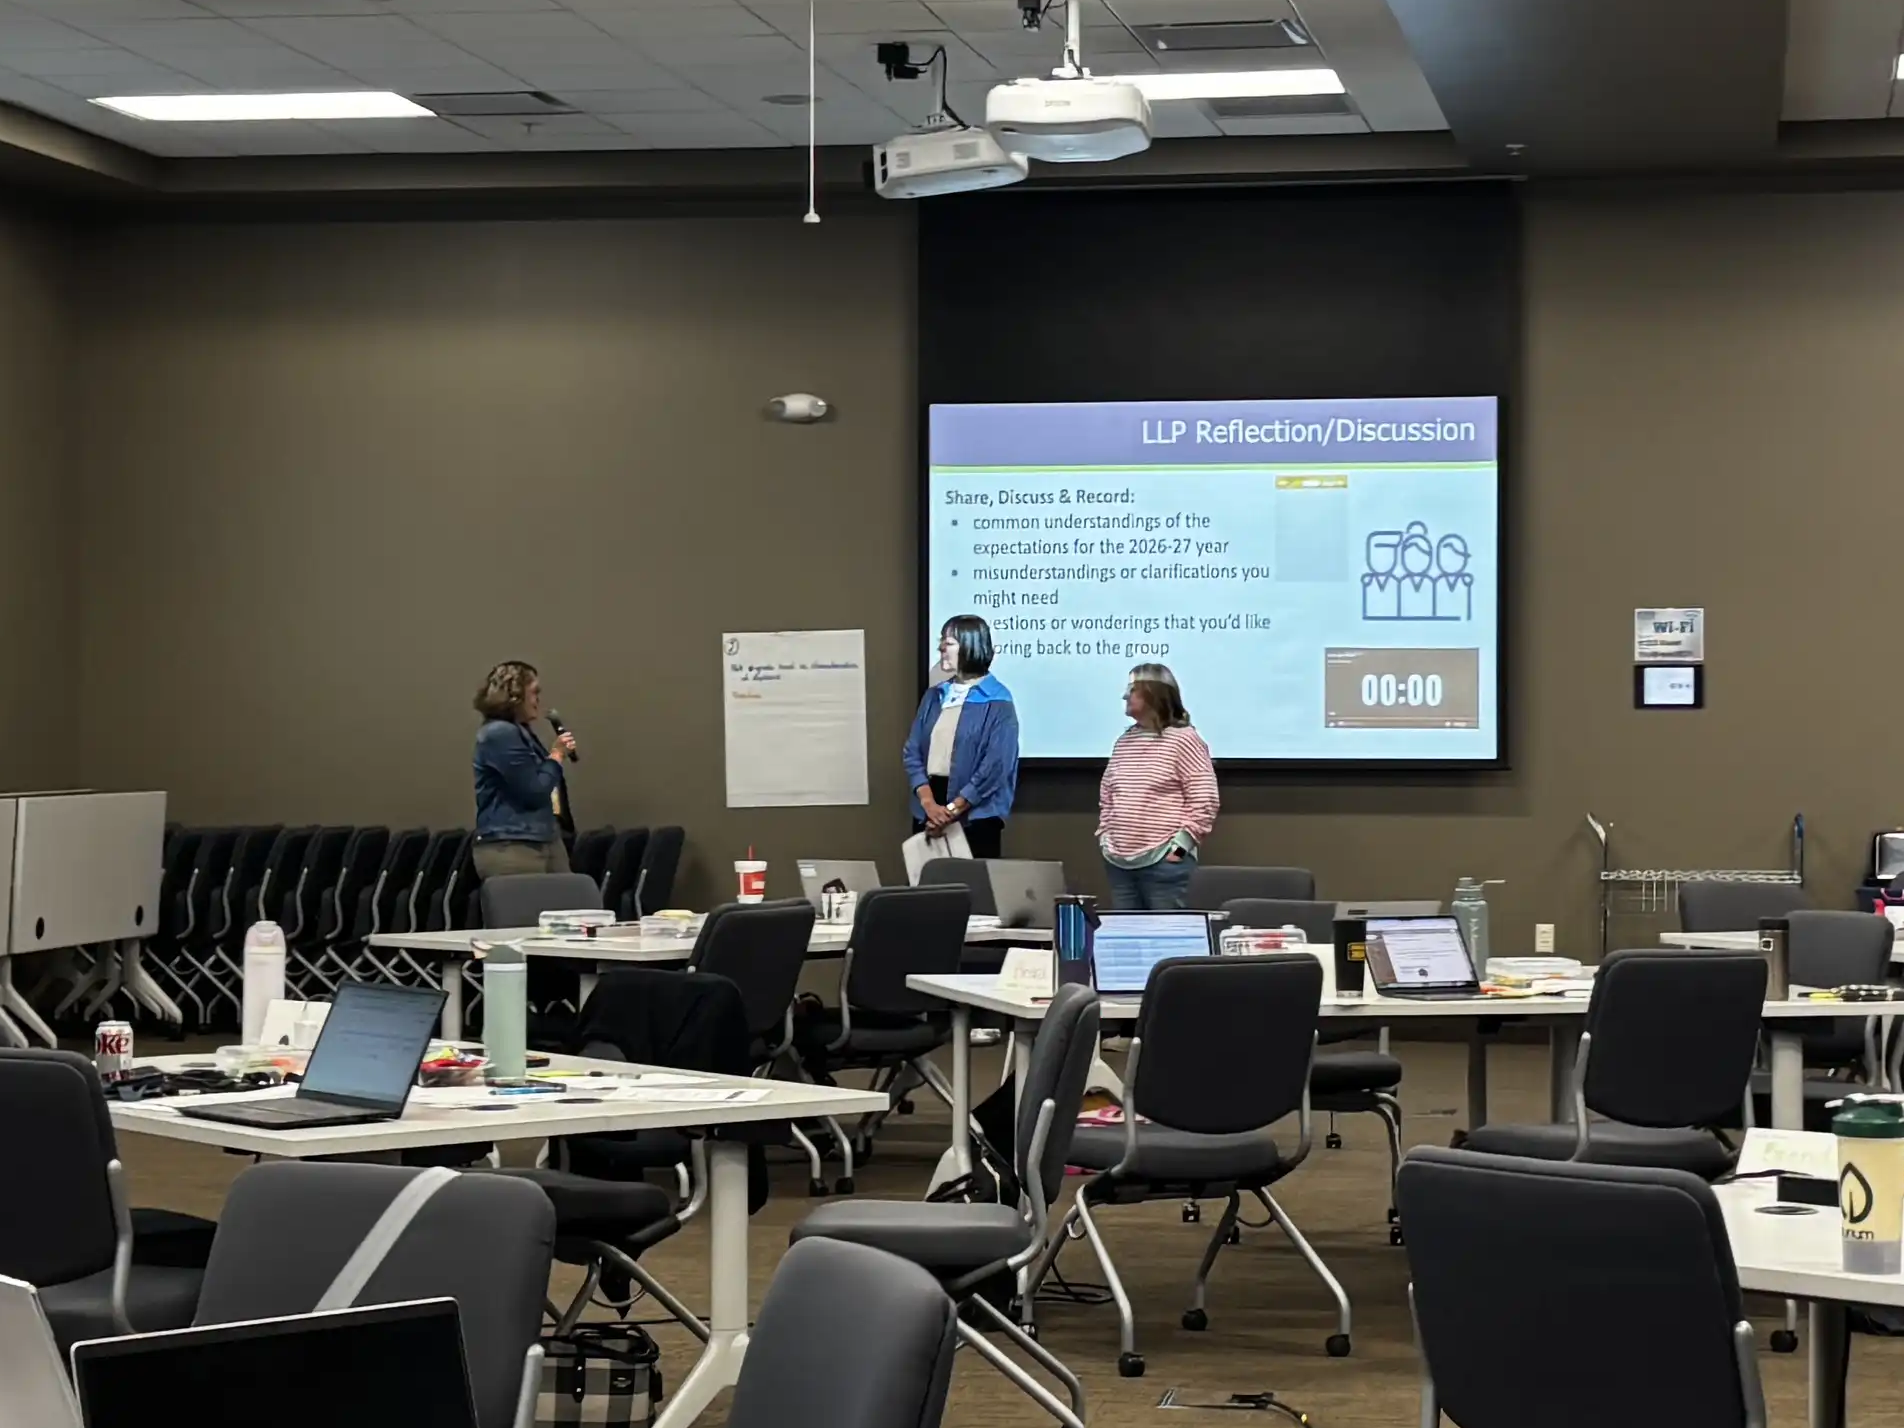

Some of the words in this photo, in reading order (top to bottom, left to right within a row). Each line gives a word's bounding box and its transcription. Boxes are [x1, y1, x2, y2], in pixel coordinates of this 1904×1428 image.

[1142, 420, 1187, 444] LLP
[1196, 417, 1476, 447] Reflection/Discussion
[945, 489, 994, 507] Share,
[998, 489, 1055, 505] Discuss
[1059, 489, 1072, 504] &
[1076, 488, 1135, 504] Record:
[973, 517, 1040, 531] common
[1045, 513, 1161, 532] understandings
[1165, 512, 1184, 529] of
[1185, 513, 1211, 529] the
[973, 538, 1069, 558] expectations
[1073, 538, 1096, 555] for
[1099, 538, 1125, 555] the
[1128, 538, 1192, 555] 2026-27
[1194, 540, 1230, 557] year
[973, 564, 1117, 582] misunderstandings
[1120, 567, 1138, 580] or
[1141, 563, 1238, 580] clarifications
[1241, 566, 1270, 582] you
[973, 590, 1017, 608] might
[1021, 589, 1059, 606] need
[992, 615, 1046, 631] estions
[1050, 617, 1068, 630] or
[1071, 615, 1161, 633] wonderings
[1164, 614, 1195, 629] that
[1245, 614, 1271, 630] like
[1036, 638, 1072, 655] back
[1075, 641, 1091, 656] to
[1095, 639, 1121, 656] the
[1125, 643, 1170, 659] group
[1361, 674, 1442, 706] 00:00
